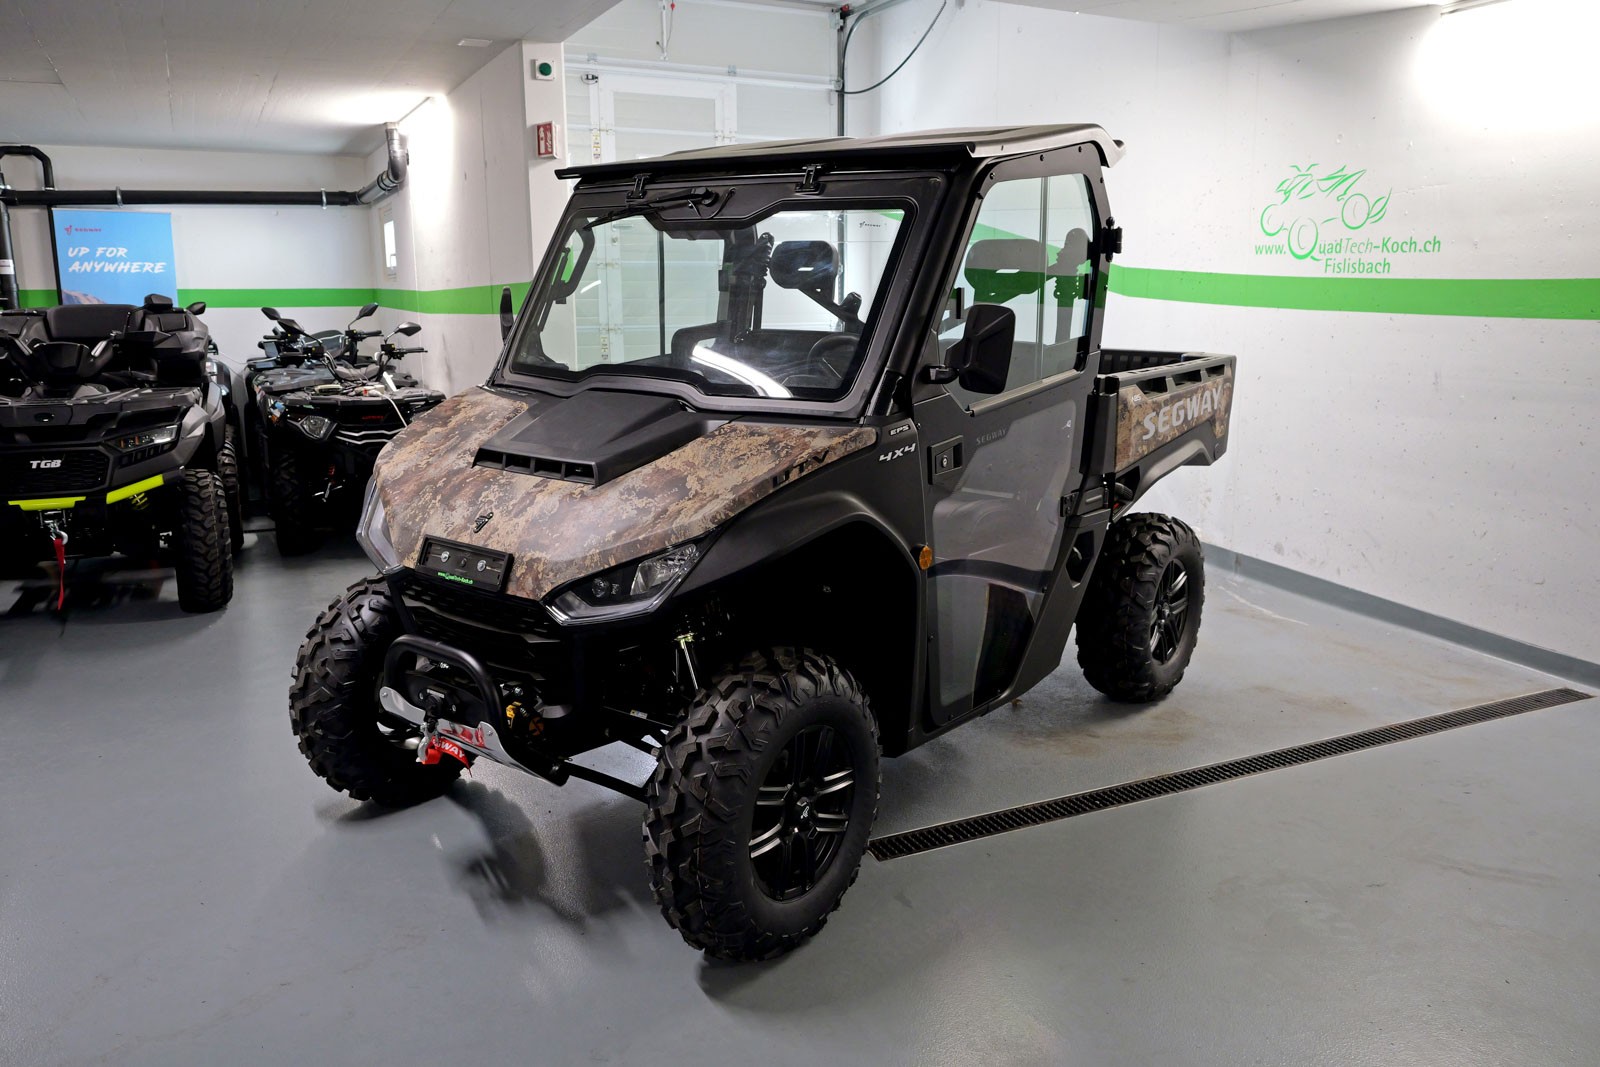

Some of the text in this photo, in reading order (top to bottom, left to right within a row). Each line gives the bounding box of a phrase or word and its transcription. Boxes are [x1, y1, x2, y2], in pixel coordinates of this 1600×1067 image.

[1255, 217, 1441, 262] www.QuadTech-Koch.ch
[67, 247, 129, 258] UP FOR
[68, 261, 167, 274] ANYWHERE
[1324, 257, 1391, 275] Fislisbach
[1142, 384, 1223, 440] SEGWAY
[889, 424, 910, 436] EPS
[976, 428, 1007, 445] SEGWAY
[30, 459, 62, 469] TGB
[772, 447, 830, 489] UTV
